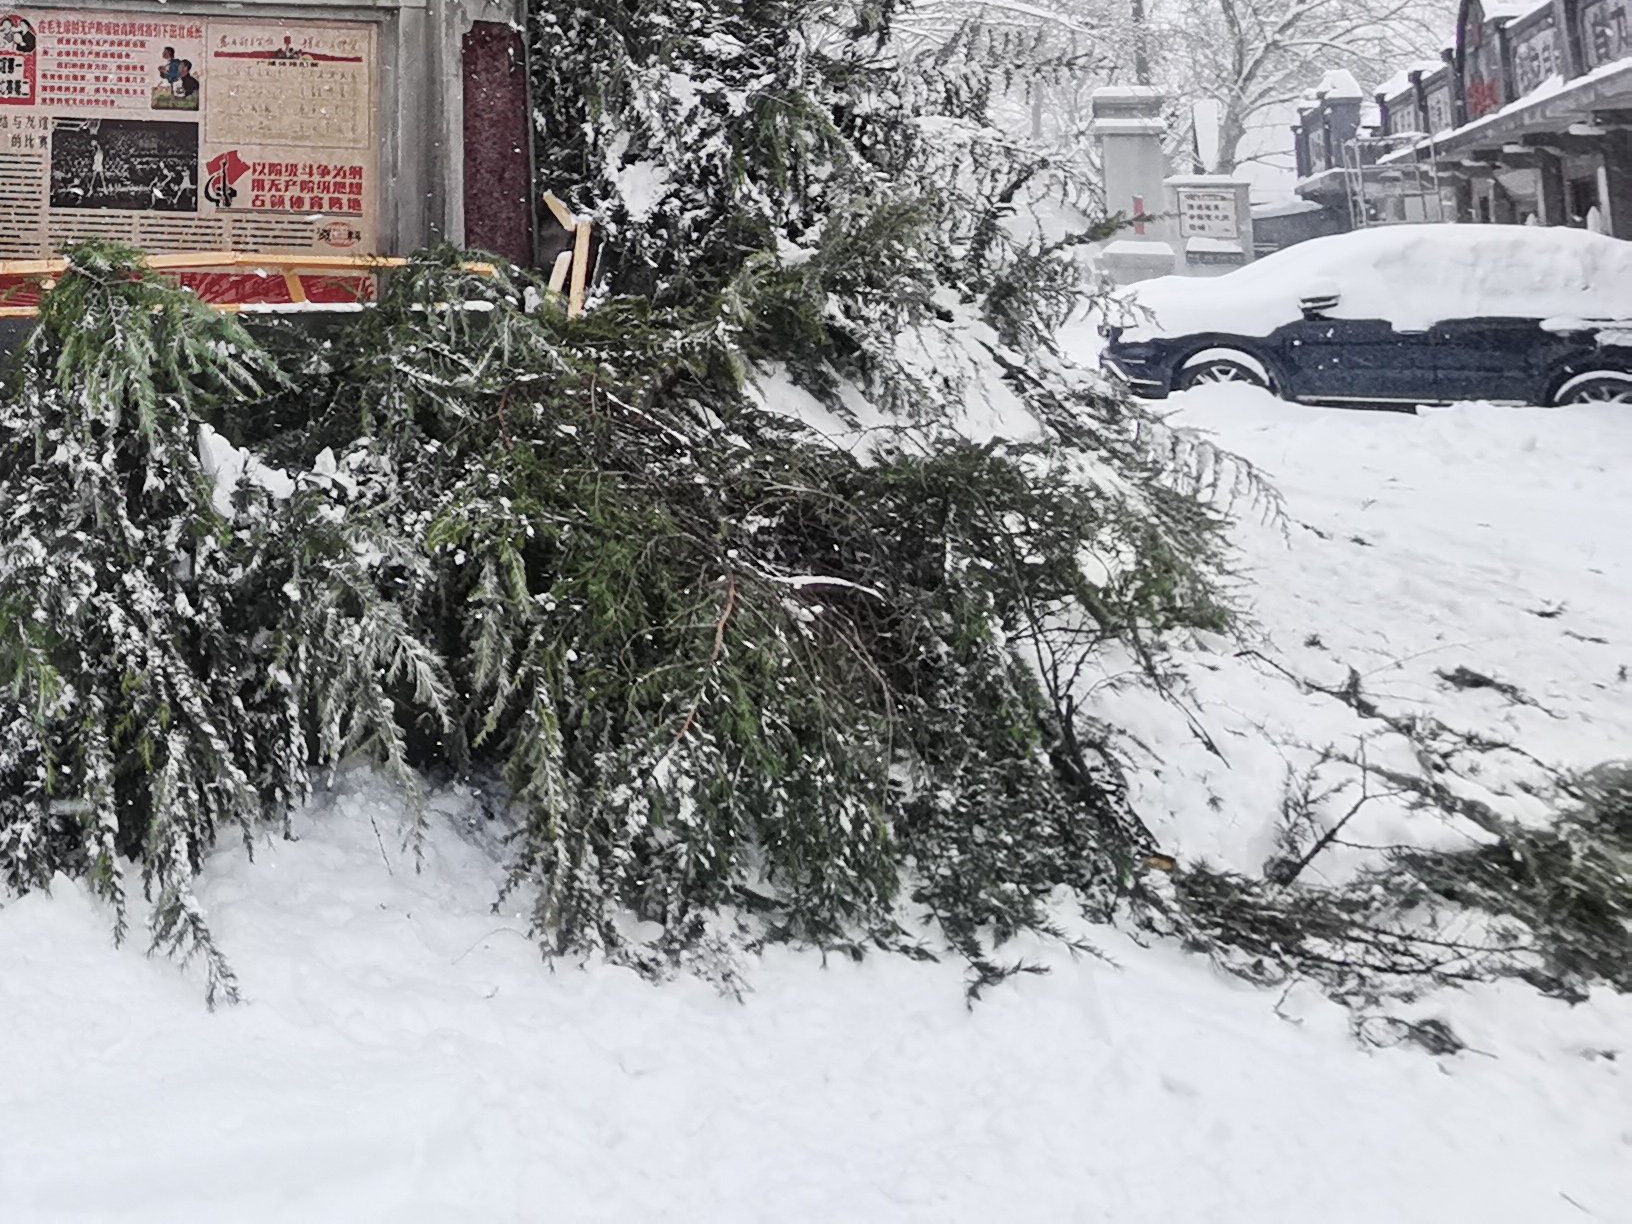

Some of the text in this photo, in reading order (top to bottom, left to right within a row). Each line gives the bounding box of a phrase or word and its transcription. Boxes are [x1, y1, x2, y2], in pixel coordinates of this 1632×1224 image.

[11, 133, 48, 150] 的比赛
[251, 161, 364, 180] 以阶级斗争为纲
[251, 178, 364, 196] 用无产阶级思想
[251, 193, 363, 211] 占领体育阵地
